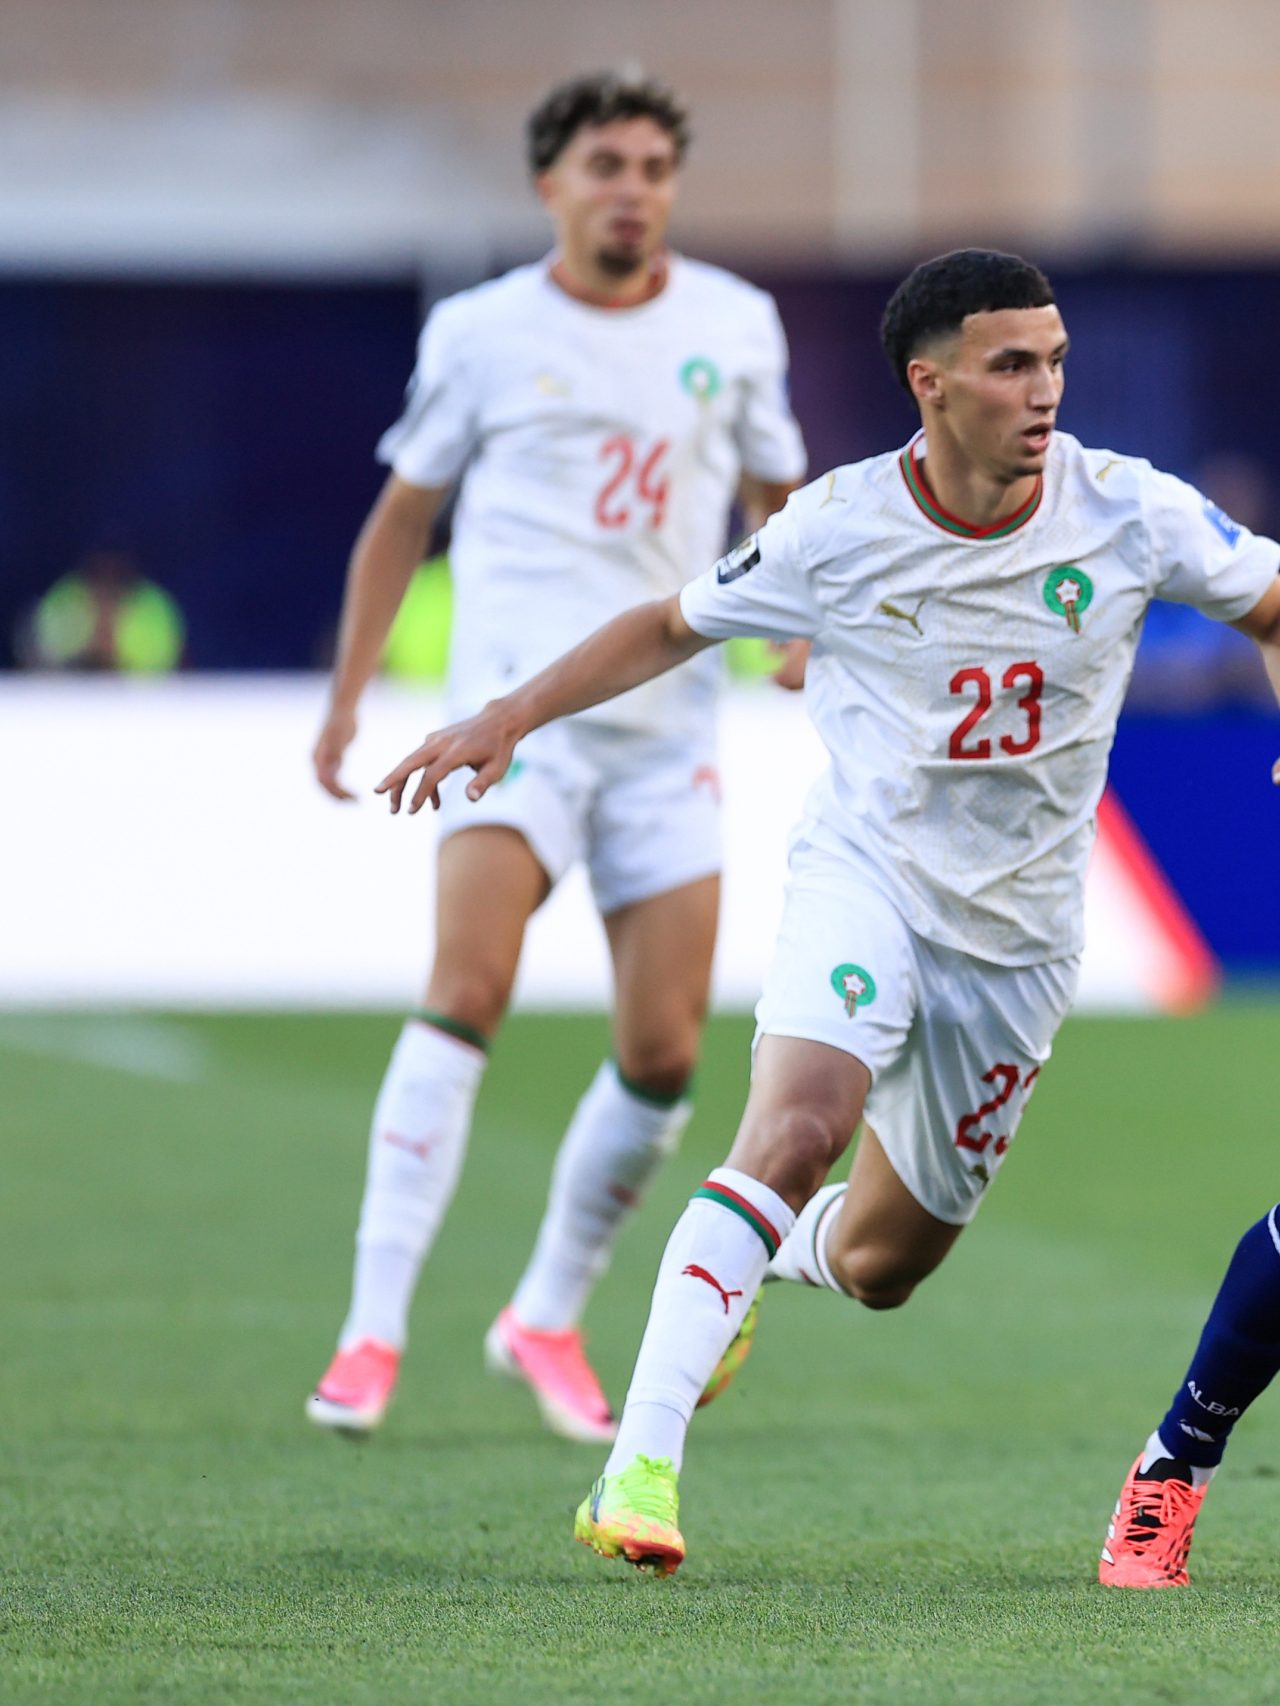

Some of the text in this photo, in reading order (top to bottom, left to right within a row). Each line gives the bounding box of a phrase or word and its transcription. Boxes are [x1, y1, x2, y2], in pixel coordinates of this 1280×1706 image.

[594, 435, 671, 529] 24
[949, 661, 1044, 759] 23
[1188, 1381, 1239, 1416] ALBA
